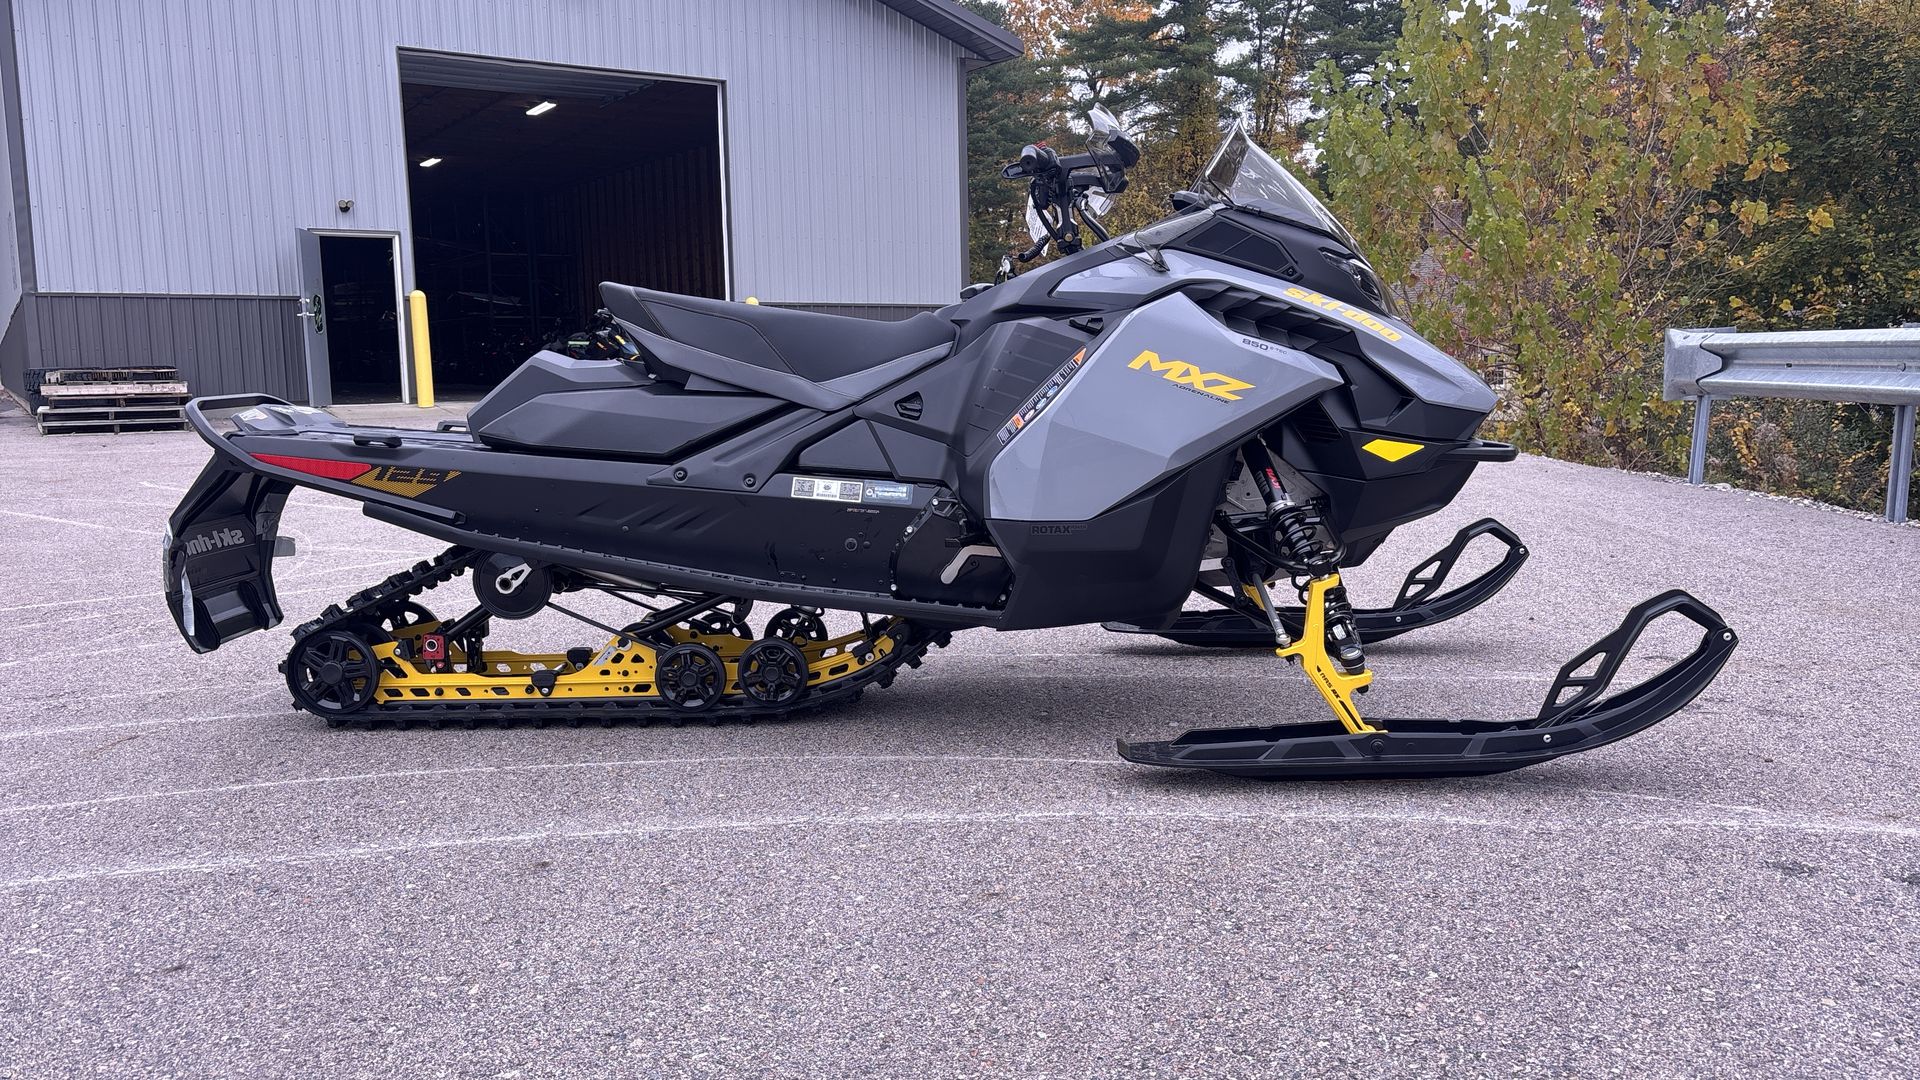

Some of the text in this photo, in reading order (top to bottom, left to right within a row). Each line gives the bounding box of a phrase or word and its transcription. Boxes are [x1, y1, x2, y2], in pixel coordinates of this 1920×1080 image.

[1283, 287, 1402, 342] ski-doo
[1242, 338, 1269, 351] 850
[1127, 349, 1257, 401] MXZ
[1172, 383, 1231, 405] ADRENALINE
[1031, 525, 1072, 535] ROTAX
